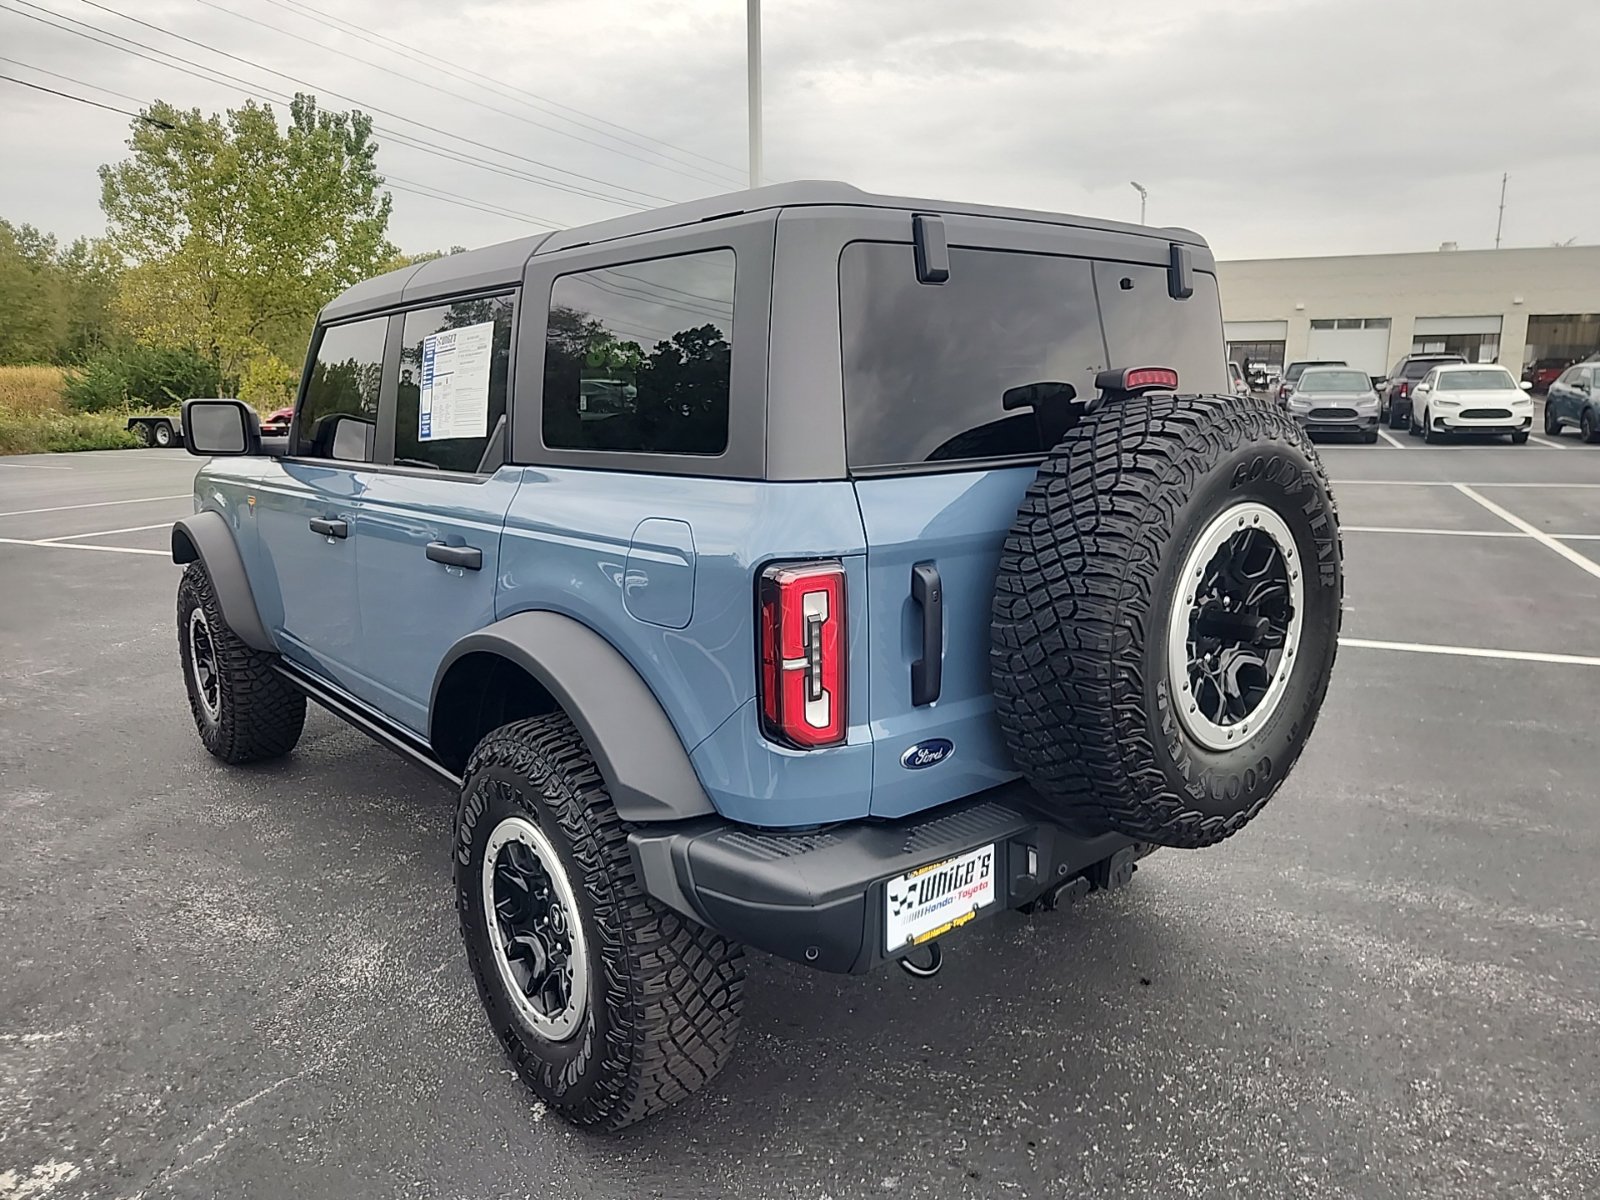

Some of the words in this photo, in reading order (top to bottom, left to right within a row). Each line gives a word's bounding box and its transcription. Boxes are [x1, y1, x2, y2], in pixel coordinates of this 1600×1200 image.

[1229, 455, 1336, 588] GOODYEAR
[914, 747, 943, 765] Ford
[957, 881, 989, 901] Toyota
